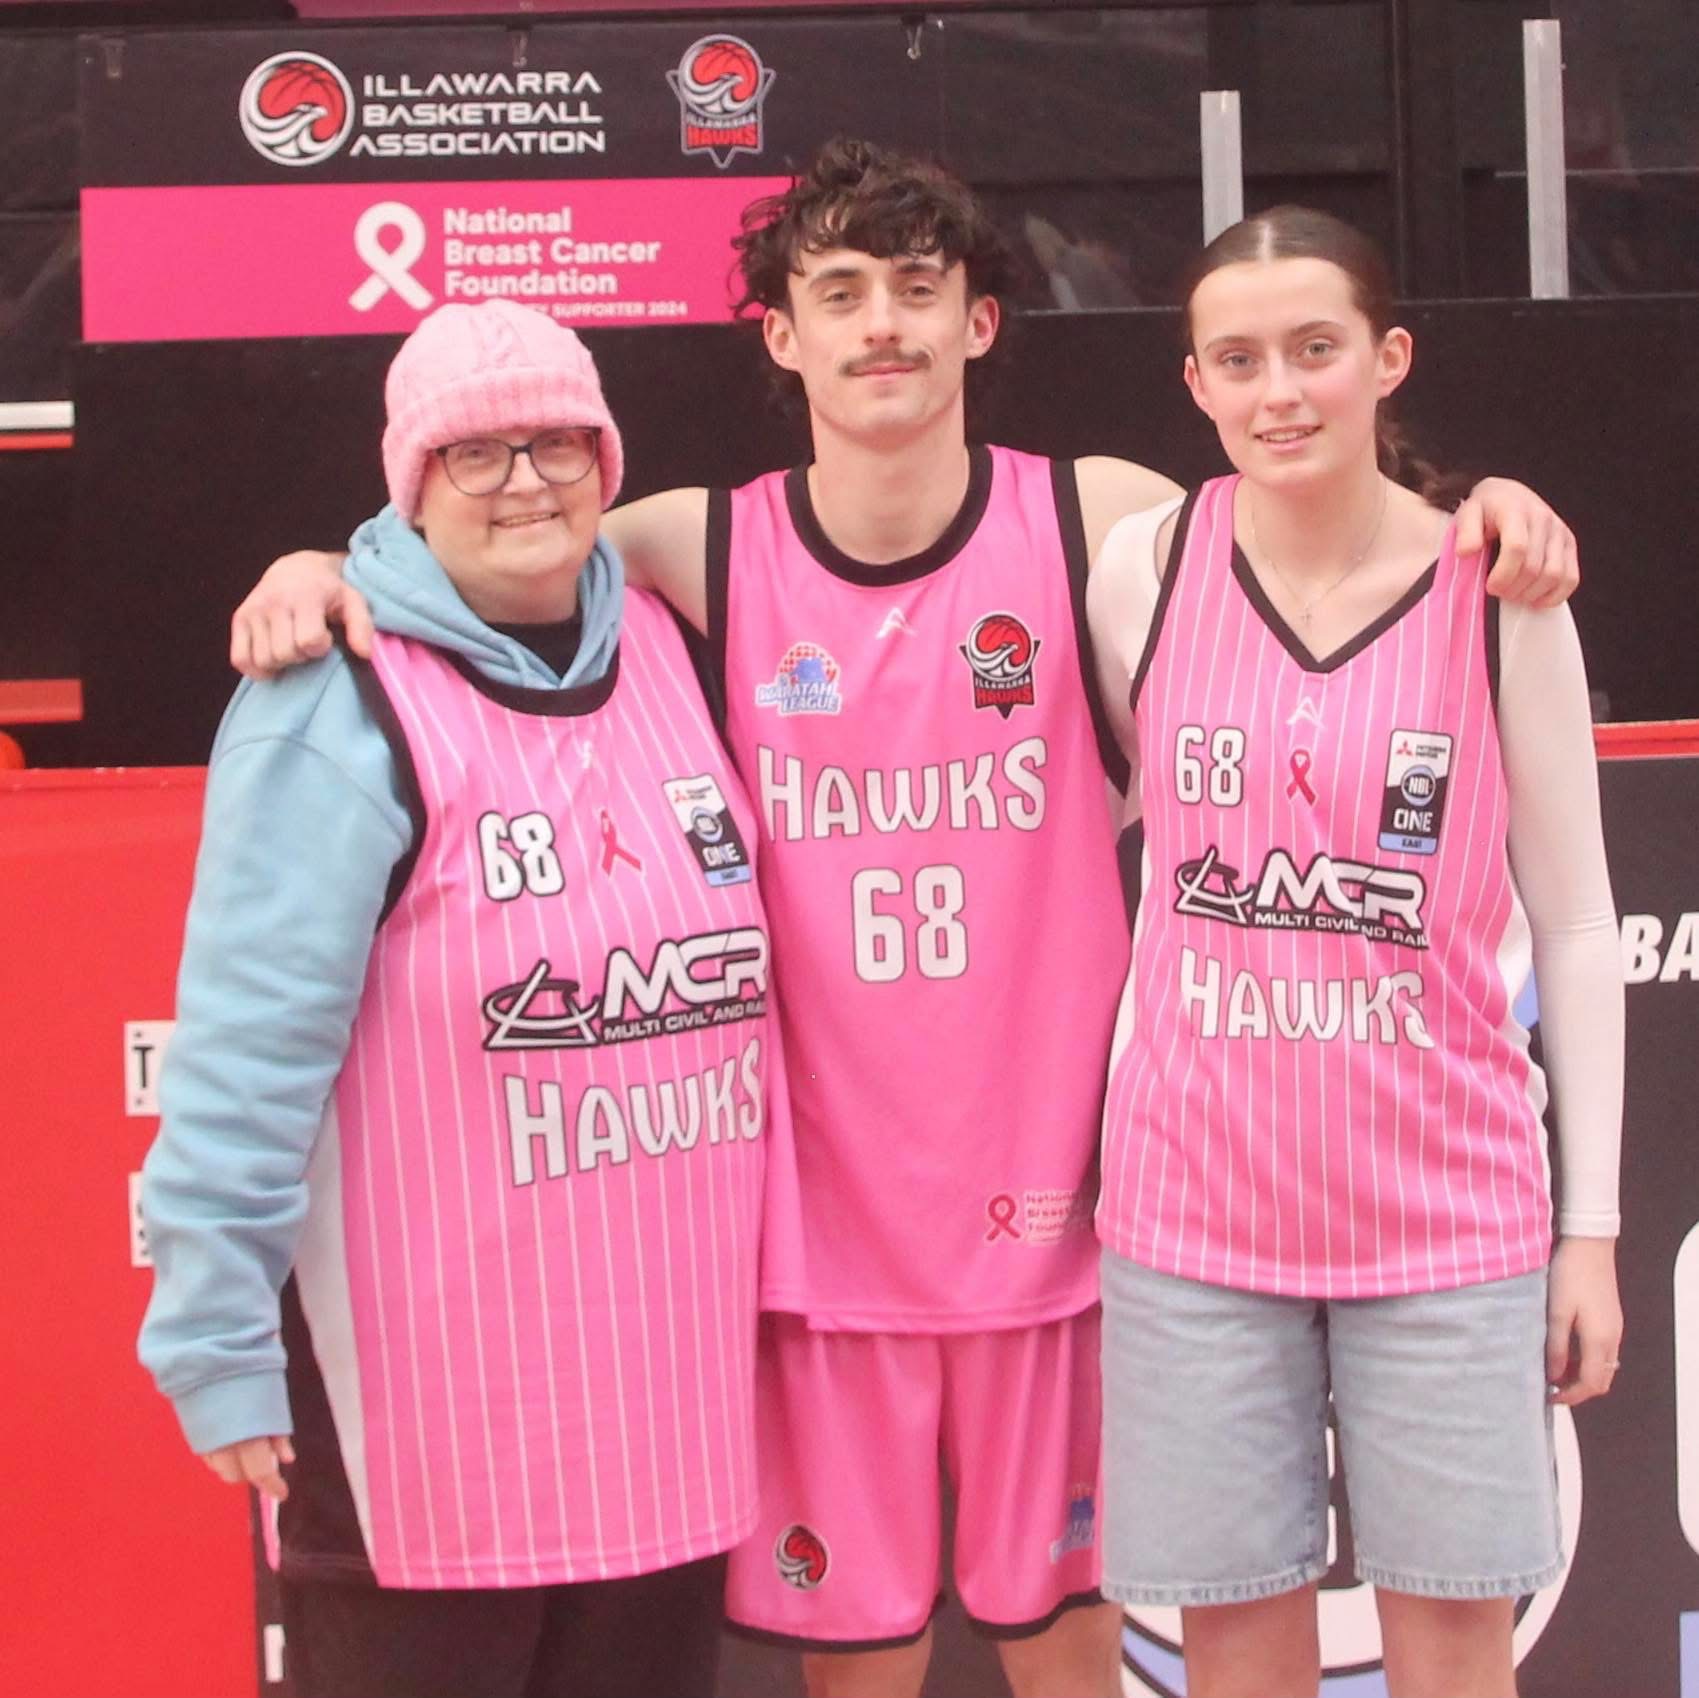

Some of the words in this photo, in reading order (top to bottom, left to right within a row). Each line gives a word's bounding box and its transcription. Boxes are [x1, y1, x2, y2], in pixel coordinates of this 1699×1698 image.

[363, 71, 602, 97] ILLAWARRA
[363, 101, 603, 127] BASKETBALL
[350, 130, 606, 157] ASSOCIATION
[444, 207, 572, 235] National
[444, 238, 543, 266] Breast
[551, 237, 662, 264] Cancer
[444, 268, 618, 297] Foundation
[552, 302, 646, 318] SUPPORTER
[648, 301, 688, 317] 2024
[1174, 724, 1247, 807] 68
[757, 736, 1048, 842] HAWKS
[1393, 808, 1434, 832] ONE
[477, 809, 566, 903] 68
[1254, 848, 1428, 931] MCR
[851, 863, 969, 983] 68
[1254, 912, 1310, 928] MULTI
[1315, 916, 1359, 932] CIVIL
[1361, 925, 1387, 939] ND
[602, 927, 769, 1020] MCR
[1180, 945, 1436, 1050] HAWKS
[603, 1019, 662, 1041] MULTI
[665, 1010, 709, 1030] CIVIL
[713, 1002, 745, 1022] AND
[503, 1037, 763, 1188] HAWKS
